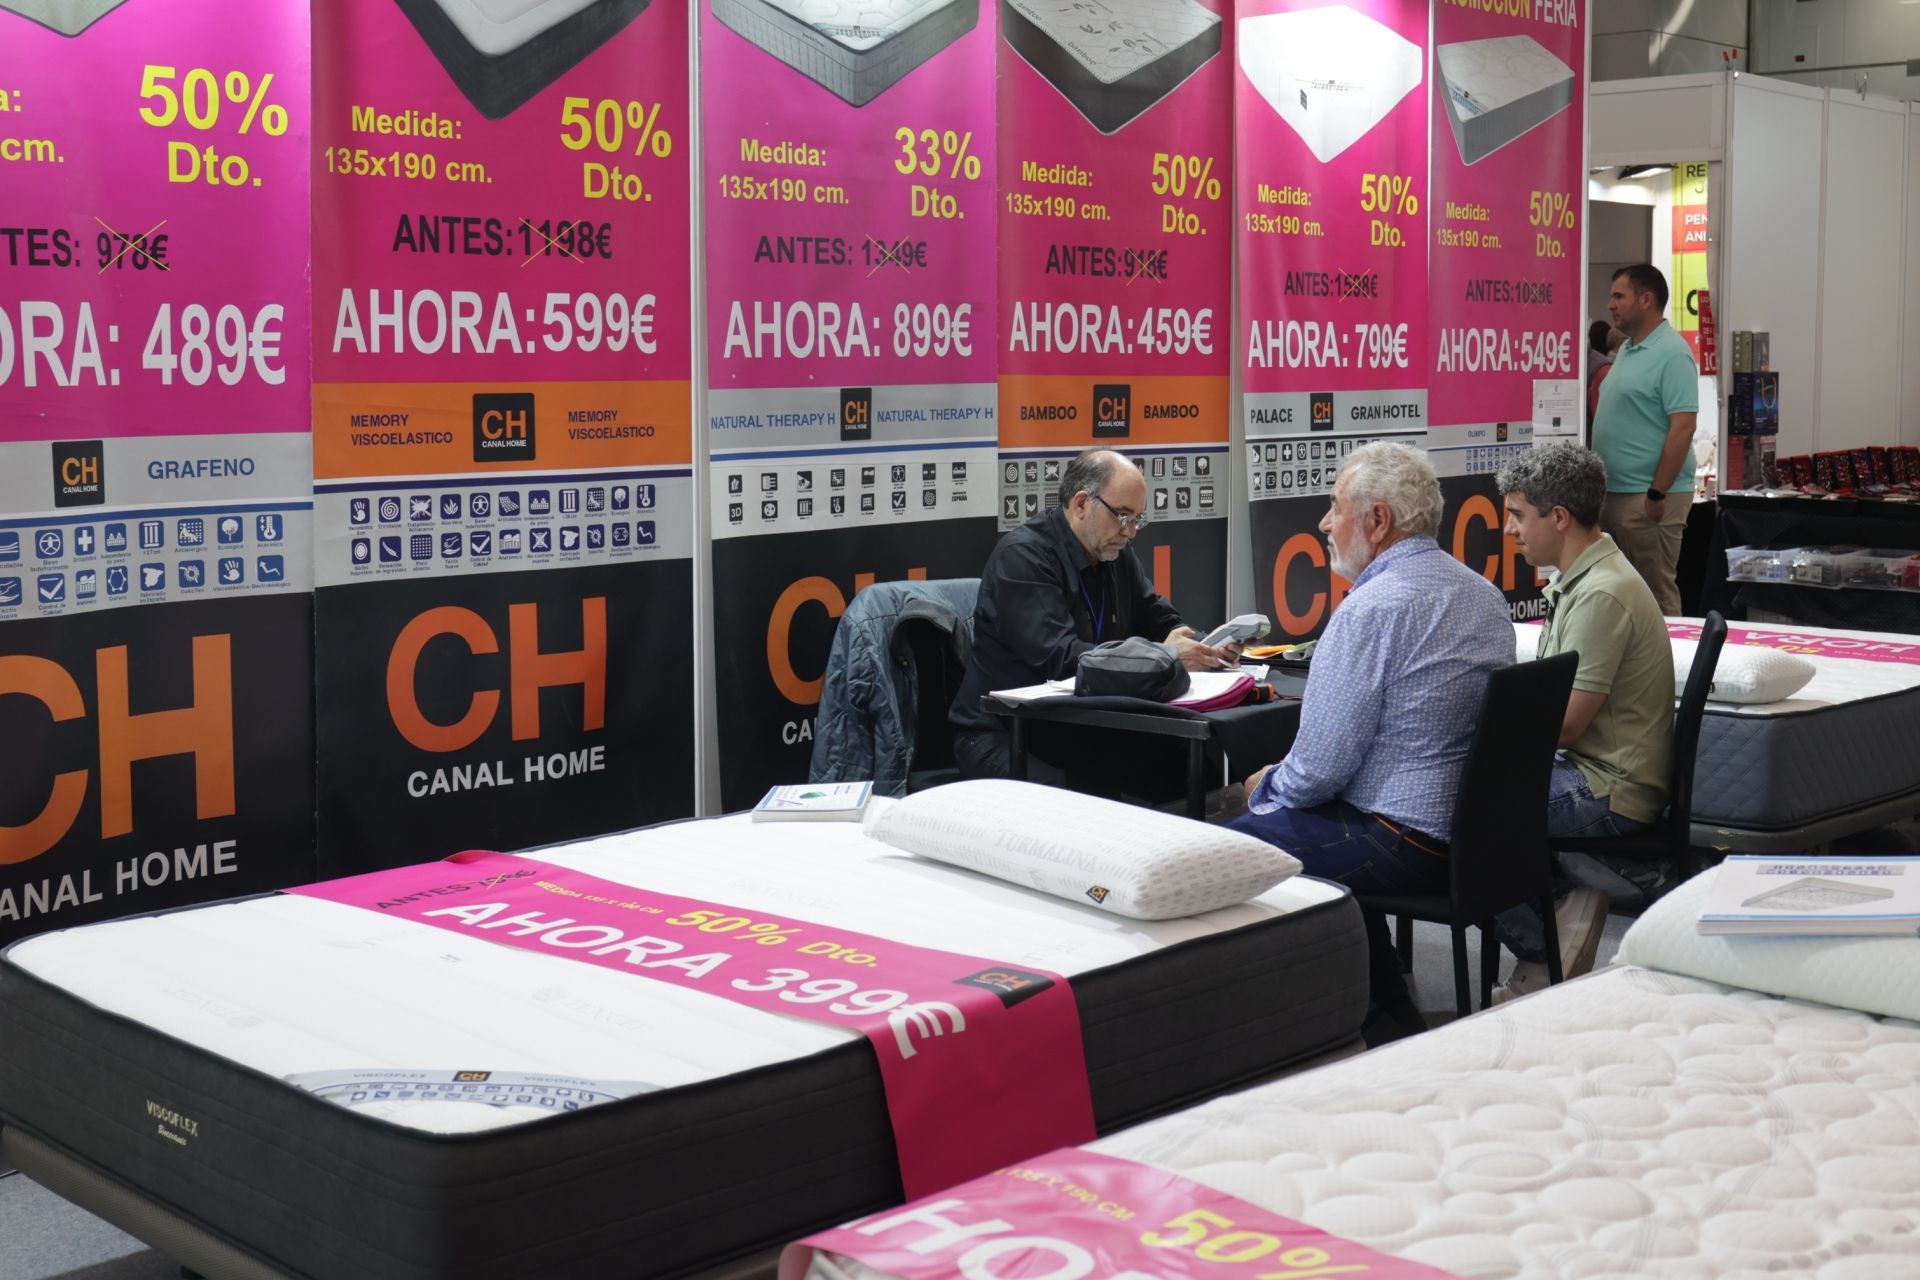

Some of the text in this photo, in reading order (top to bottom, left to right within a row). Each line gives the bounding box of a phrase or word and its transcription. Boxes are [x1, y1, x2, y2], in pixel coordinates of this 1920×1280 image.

[1535, 0, 1577, 28] FERIA
[139, 64, 289, 137] 50%
[351, 105, 462, 139] Medida:
[560, 96, 672, 158] 50%
[1, 137, 65, 162] cm.
[741, 138, 827, 166] Medida:
[894, 126, 981, 180] 33%
[168, 141, 262, 187] Dto.
[325, 146, 493, 183] 135x190 cm.
[1022, 160, 1093, 187] Medida:
[1151, 152, 1221, 200] 50%
[583, 162, 652, 202] Dto.
[719, 175, 849, 204] 135x190 cm.
[1258, 183, 1312, 206] Medida:
[1360, 173, 1418, 216] 50%
[911, 185, 964, 219] Dto.
[1006, 192, 1111, 221] 135x190 cm.
[1446, 201, 1490, 221] Medida:
[1529, 190, 1575, 229] 50%
[1162, 204, 1207, 235] Dto.
[1245, 213, 1325, 237] 135x190 cm.
[1371, 219, 1406, 247] Dto.
[96, 231, 170, 272] 978€
[754, 235, 928, 268] ANTES: 1349€
[1437, 228, 1502, 249] 135x190 cm.
[1536, 233, 1566, 258] Dto.
[723, 300, 972, 359] AHORA: 899€
[142, 303, 286, 386] 489€
[1247, 319, 1409, 369] AHORA: 799€
[351, 414, 409, 427] MEMORY
[568, 410, 618, 422] MEMORY
[711, 412, 835, 430] NATURAL THERAPY H
[844, 400, 868, 424] CH
[877, 408, 993, 423] NATURAL THERAPY H
[1021, 406, 1077, 420] BAMBOO
[1099, 397, 1126, 420] CH
[1144, 404, 1199, 419] BAMBOO
[1250, 408, 1293, 424] PALACE
[1313, 401, 1331, 419] CH
[1351, 404, 1420, 420] GRAN HOTEL
[481, 410, 527, 439] CH
[568, 426, 655, 439] VISCOELASTICO
[351, 432, 453, 446] VISCOELASTICO
[482, 440, 506, 448] CANAL
[62, 457, 98, 485] CH
[147, 457, 255, 480] GRAFENO
[386, 596, 607, 752] CH
[407, 745, 606, 798] CANAL HOME
[116, 839, 238, 895] HOME
[376, 884, 470, 909] ANTES
[533, 881, 583, 897] MEDIDA
[665, 910, 879, 968] 50% Dto.
[421, 902, 966, 1060] AHORA 399€
[980, 972, 1033, 989] CH
[146, 1099, 198, 1137] VISCOFLEX
[1061, 1184, 1099, 1204] 190
[1097, 1202, 1137, 1221] CM
[1139, 1208, 1372, 1280] 50%
